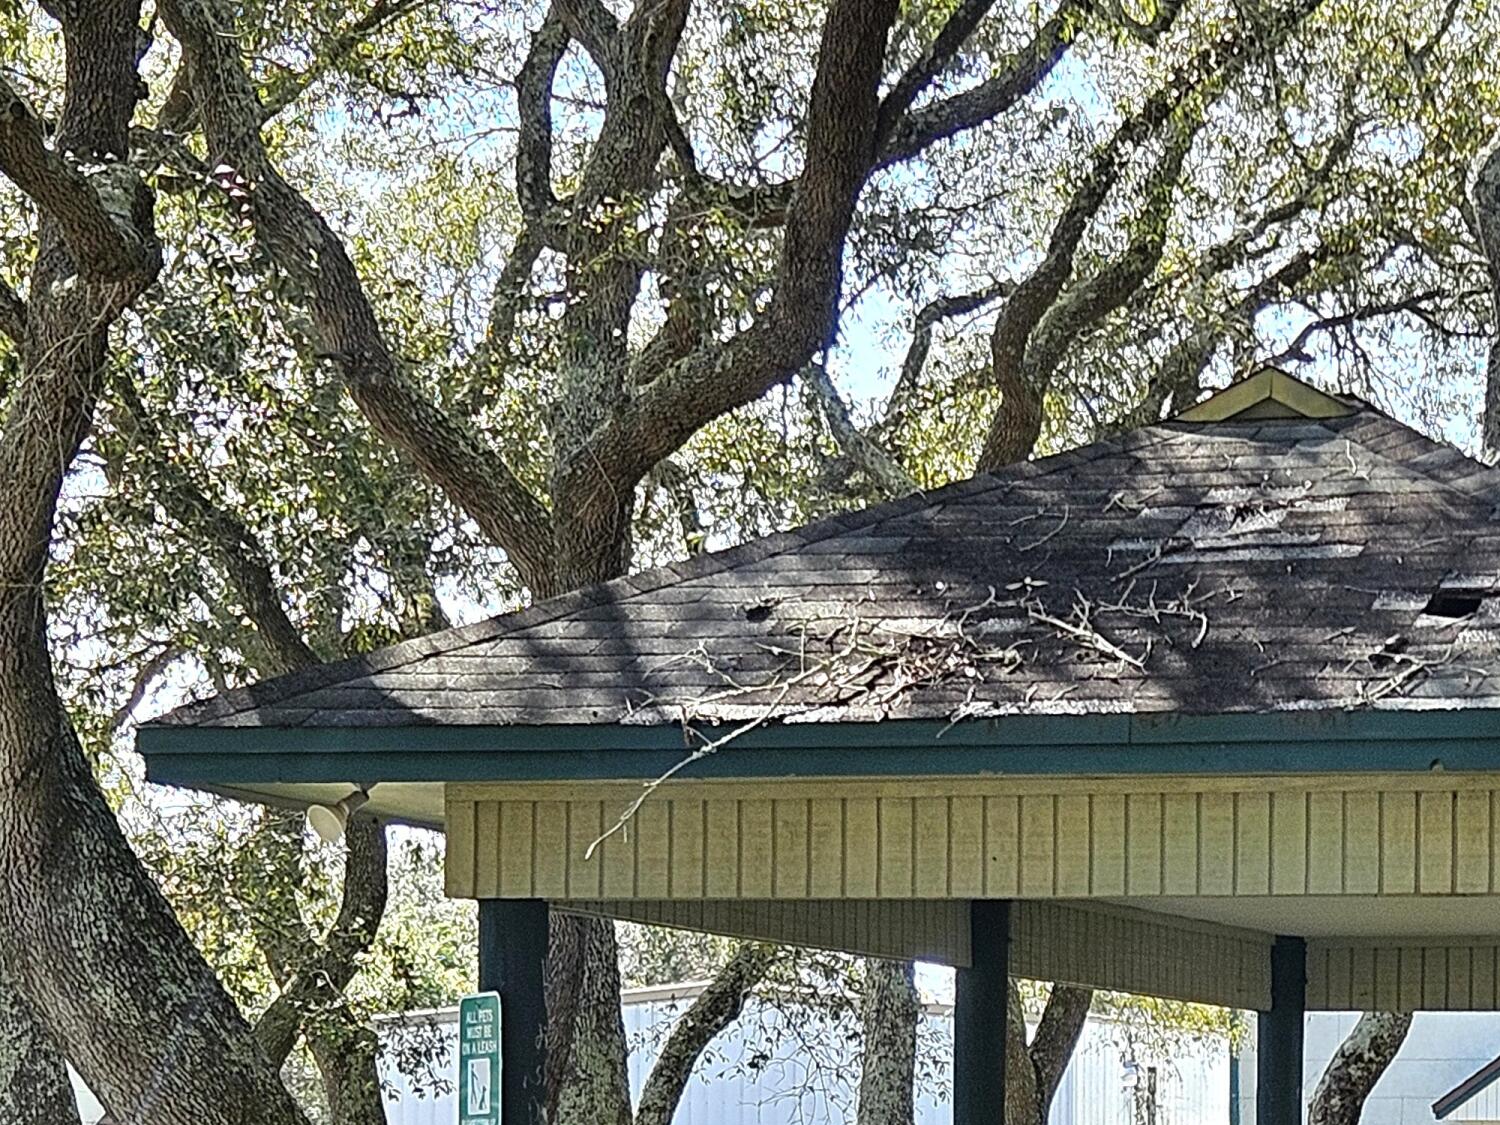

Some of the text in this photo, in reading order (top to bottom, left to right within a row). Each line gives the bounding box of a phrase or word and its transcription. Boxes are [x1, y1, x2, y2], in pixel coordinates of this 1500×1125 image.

[466, 1009, 493, 1024] ALL PETS
[466, 1024, 492, 1039] MUST BE
[462, 1042, 471, 1056] ON
[477, 1040, 497, 1054] LEASH
